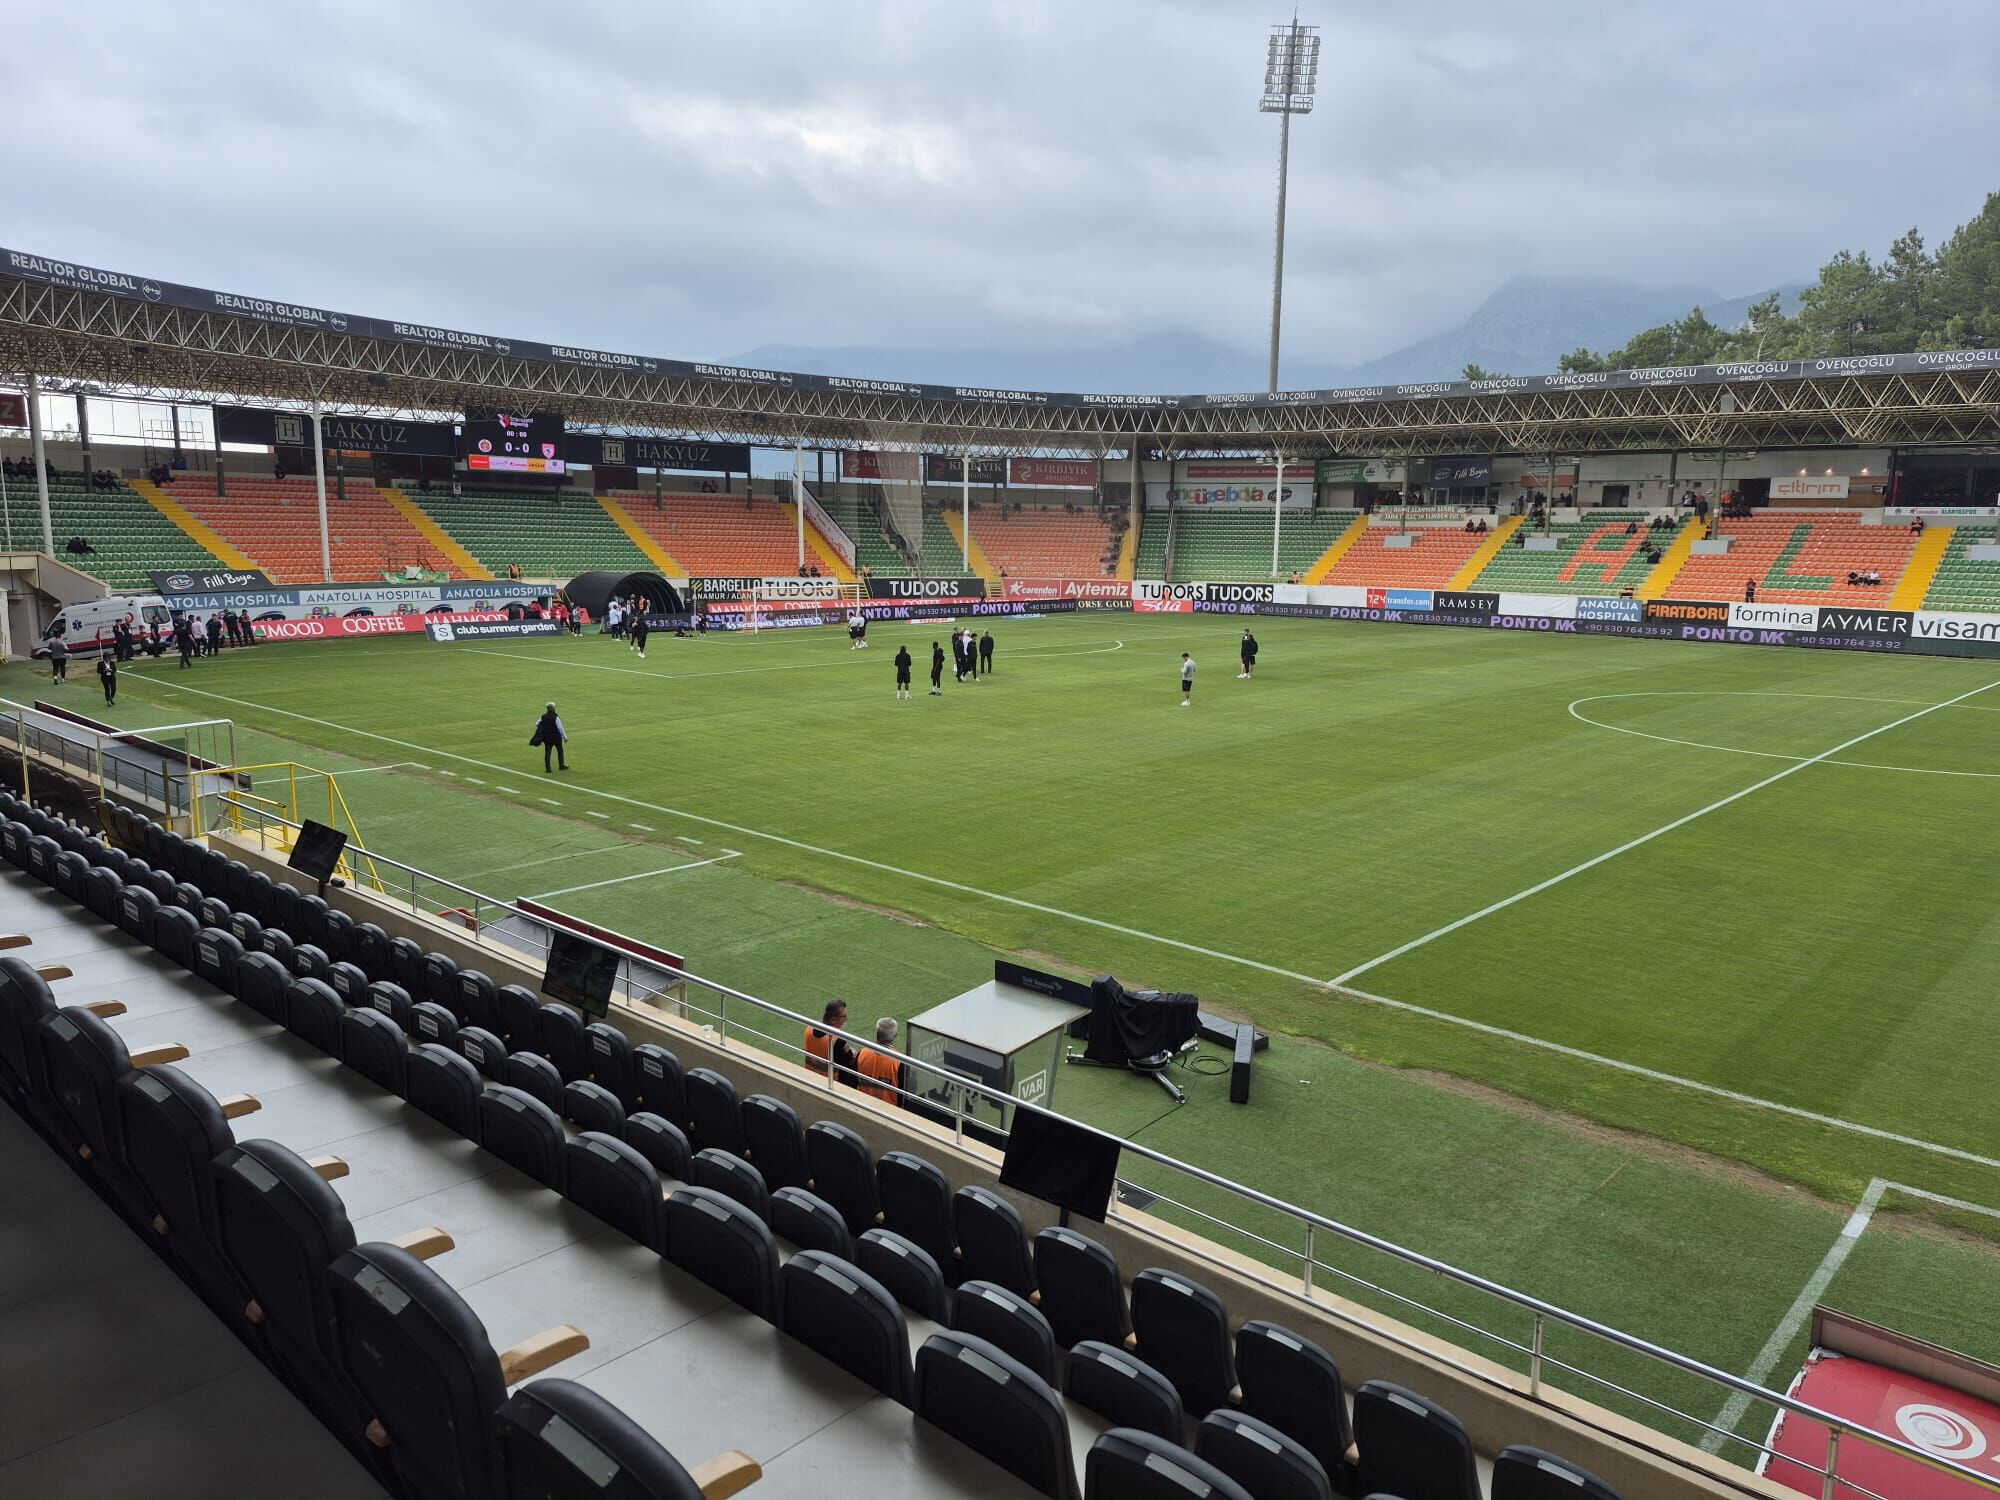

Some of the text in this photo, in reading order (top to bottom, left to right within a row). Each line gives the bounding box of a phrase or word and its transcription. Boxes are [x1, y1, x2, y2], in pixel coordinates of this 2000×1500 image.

[10, 252, 137, 291] REALTOR GLOBAL
[51, 277, 69, 287] REAL
[215, 294, 326, 322] REALTOR GLOBAL
[394, 323, 492, 348] REALTOR GLOBAL
[552, 346, 641, 367] REALTOR GLOBAL
[695, 364, 777, 381] REALTOR GLOBAL
[1739, 374, 1762, 382] GROUP
[828, 378, 906, 393] REALTOR GLOBAL
[956, 388, 1032, 401] REALTOR GLOBAL
[1083, 394, 1162, 405] REALTOR GLOBAL
[505, 442, 512, 452] 0
[522, 443, 530, 453] 0
[636, 443, 710, 462] HAKYÜZ
[1035, 464, 1088, 476] KIRBIYIK
[203, 572, 256, 588] Filli Boya
[704, 578, 762, 592] BARGELLO
[446, 586, 556, 599] ANATOLIA HOSPITAL
[765, 580, 834, 597] TUDORS
[889, 580, 959, 596] TUDORS
[1021, 582, 1129, 598] corendon Aytemiz
[1142, 584, 1204, 600] TUDORS
[1210, 586, 1273, 602] TUDORS
[224, 594, 294, 606] HOSPITAL
[306, 589, 436, 603] ANATOLIA HOSPITAL
[692, 592, 724, 600] ANAMUR
[972, 602, 1010, 615] PONTO
[1012, 602, 1026, 613] MK
[1106, 600, 1132, 608] GOLD
[1194, 600, 1237, 614] PONTO
[1240, 603, 1256, 614] MK
[1261, 606, 1274, 614] +90
[1314, 608, 1325, 616] 92
[1440, 598, 1494, 610] RAMSEY
[1580, 600, 1638, 610] ANATOLIA
[894, 606, 910, 618] MK
[1330, 607, 1380, 620] PONTO
[1384, 610, 1402, 622] MK
[1425, 614, 1440, 622] 530
[1578, 610, 1638, 622] HOSPITAL
[1648, 604, 1729, 621] FIRATBORU
[1736, 606, 1813, 624] formina
[342, 616, 406, 633] COFFEE
[456, 622, 556, 634] club summer garden
[1490, 615, 1673, 636] PONTO MK +90 530 764 35 92
[1822, 614, 1908, 633] AYMER
[1682, 626, 1901, 649] PONTO MK +90 530 764 35 92
[1021, 1078, 1043, 1099] VAR
